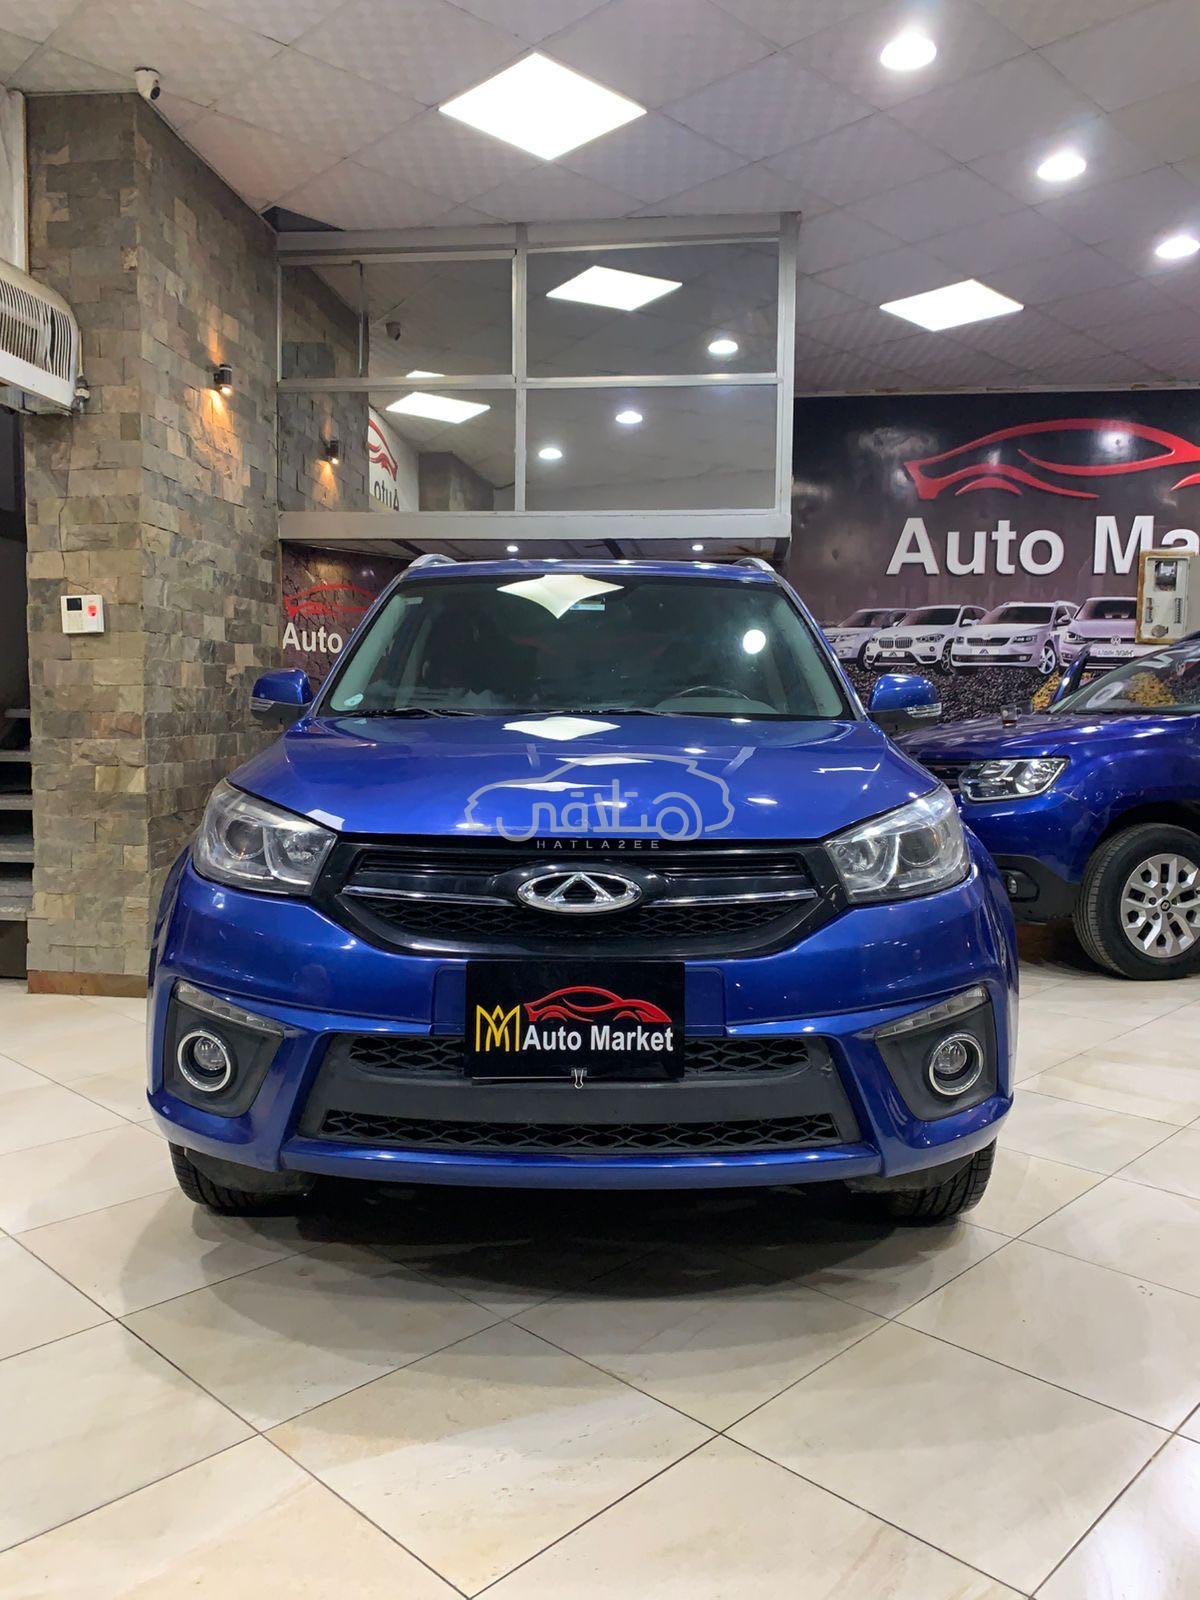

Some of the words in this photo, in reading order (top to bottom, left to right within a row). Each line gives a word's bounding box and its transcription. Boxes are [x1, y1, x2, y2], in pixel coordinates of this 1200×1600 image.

[886, 516, 1064, 576] Auto
[283, 622, 343, 653] Auto
[523, 1025, 582, 1050] Auto
[591, 1025, 674, 1051] Market
